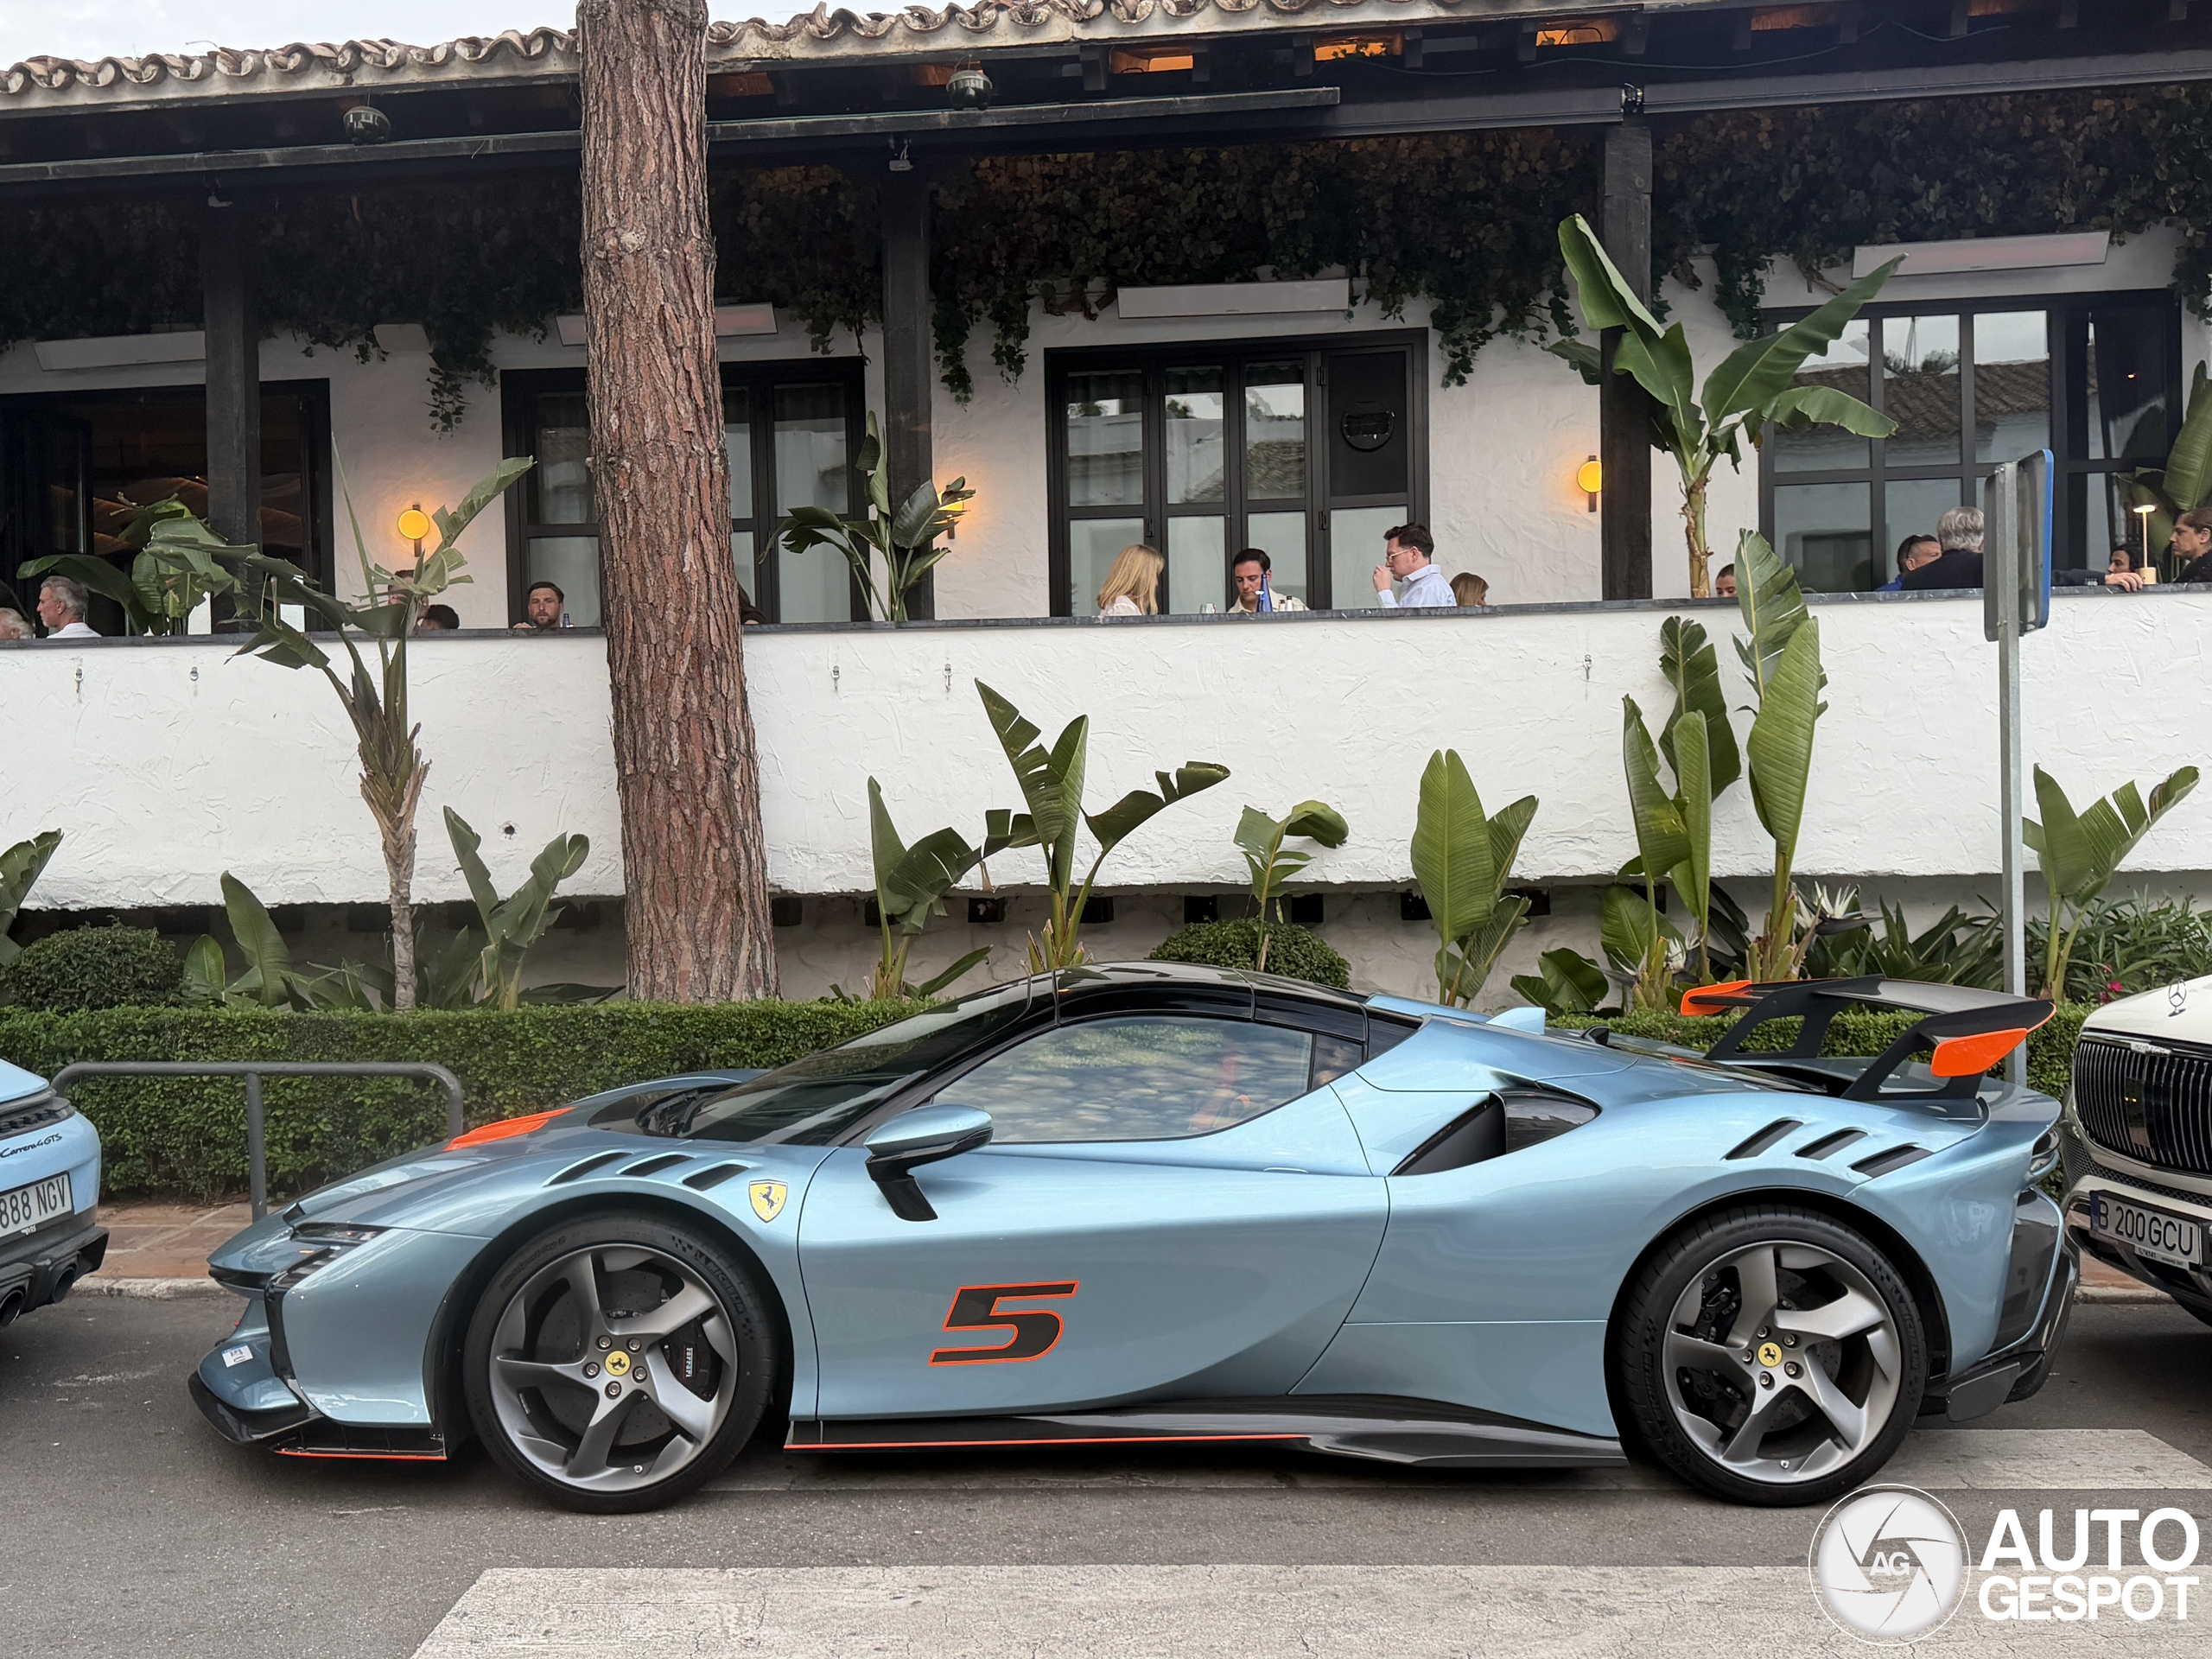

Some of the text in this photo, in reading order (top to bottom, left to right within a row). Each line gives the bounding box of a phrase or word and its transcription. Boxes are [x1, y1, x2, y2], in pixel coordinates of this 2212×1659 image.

[35, 1176, 66, 1217] NGV
[2099, 1200, 2193, 1256] B 200 GCU
[706, 1262, 747, 1314] MICHELIN
[928, 1279, 1079, 1366] 5
